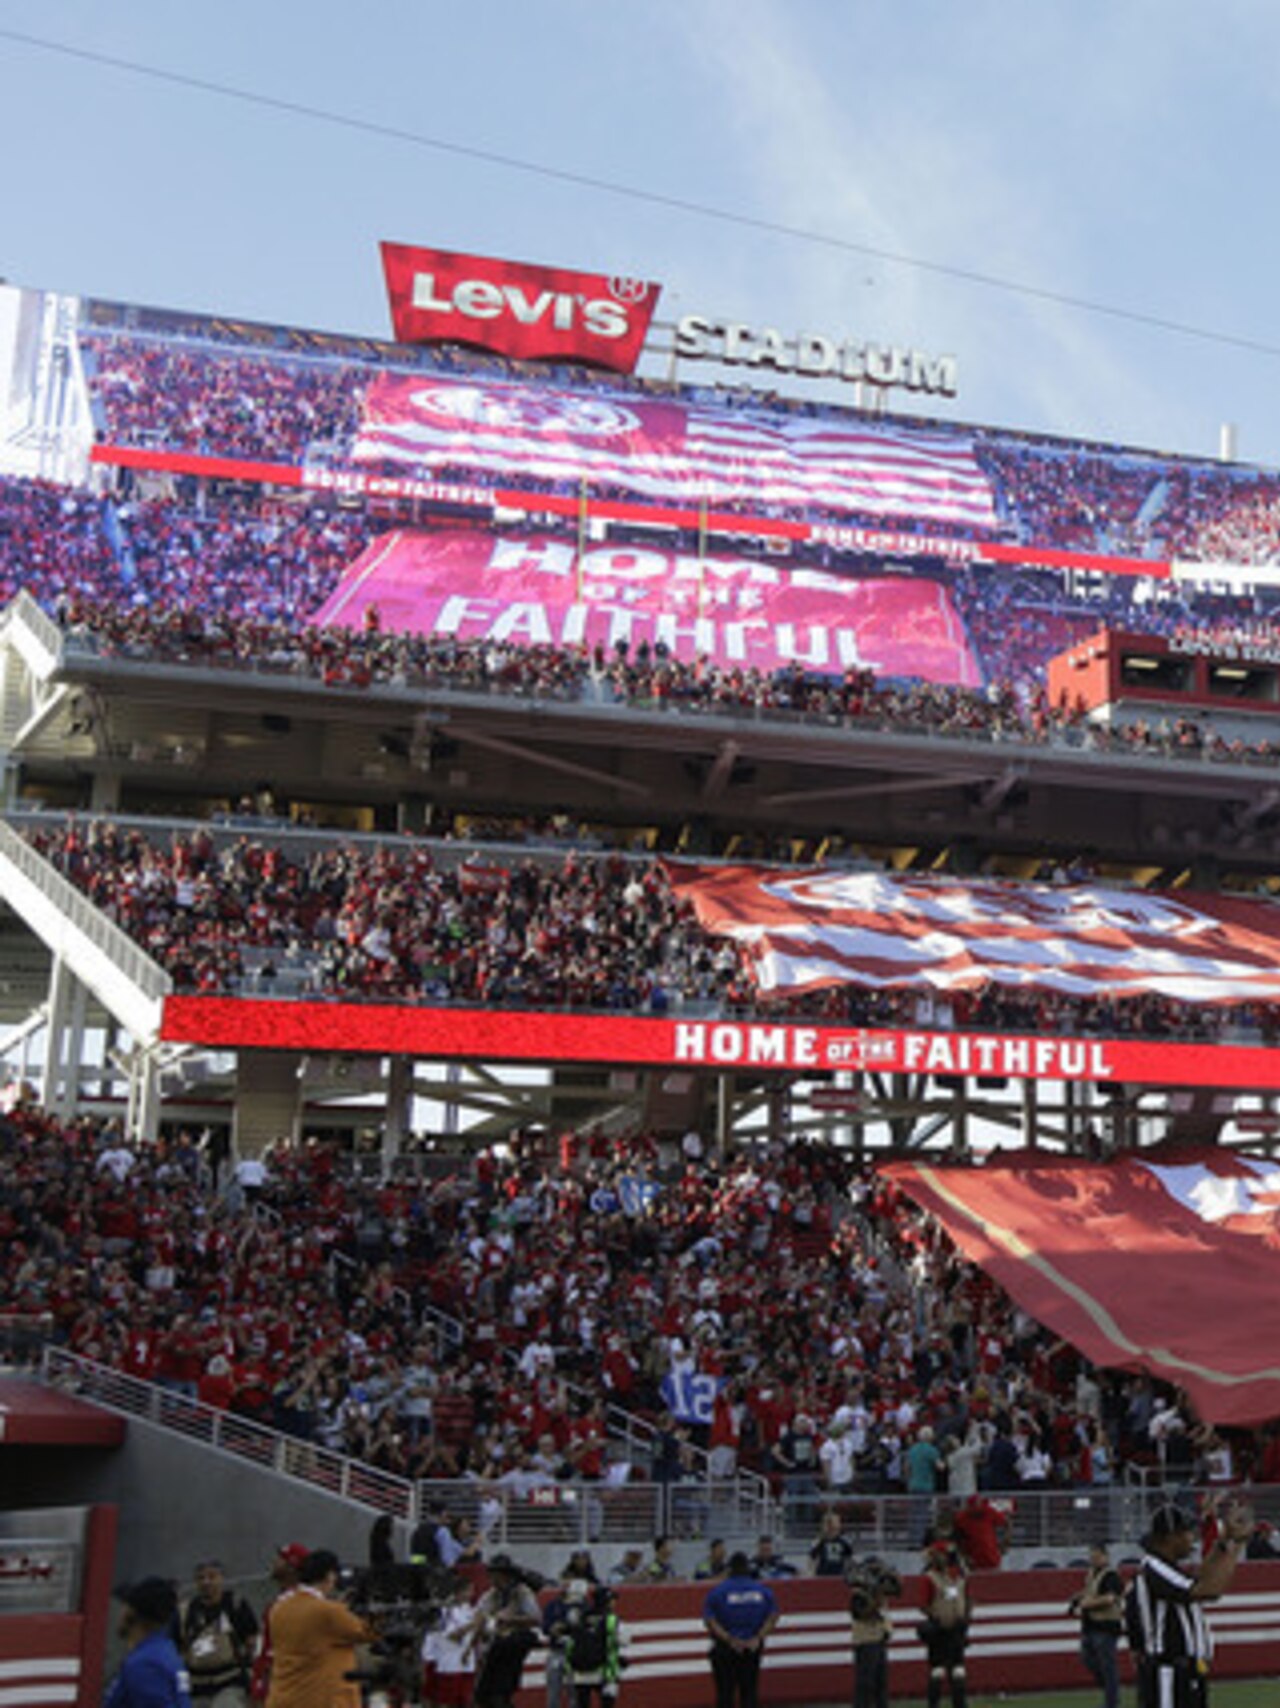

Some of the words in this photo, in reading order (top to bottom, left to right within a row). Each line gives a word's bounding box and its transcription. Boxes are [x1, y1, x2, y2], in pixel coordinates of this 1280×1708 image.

[677, 314, 957, 398] STADIUM
[488, 538, 858, 593] HOME
[673, 1023, 817, 1063] HOME
[826, 1041, 854, 1060] OF
[857, 1040, 895, 1059] THE
[904, 1035, 1112, 1076] FAITHFUL
[671, 1368, 716, 1421] 12
